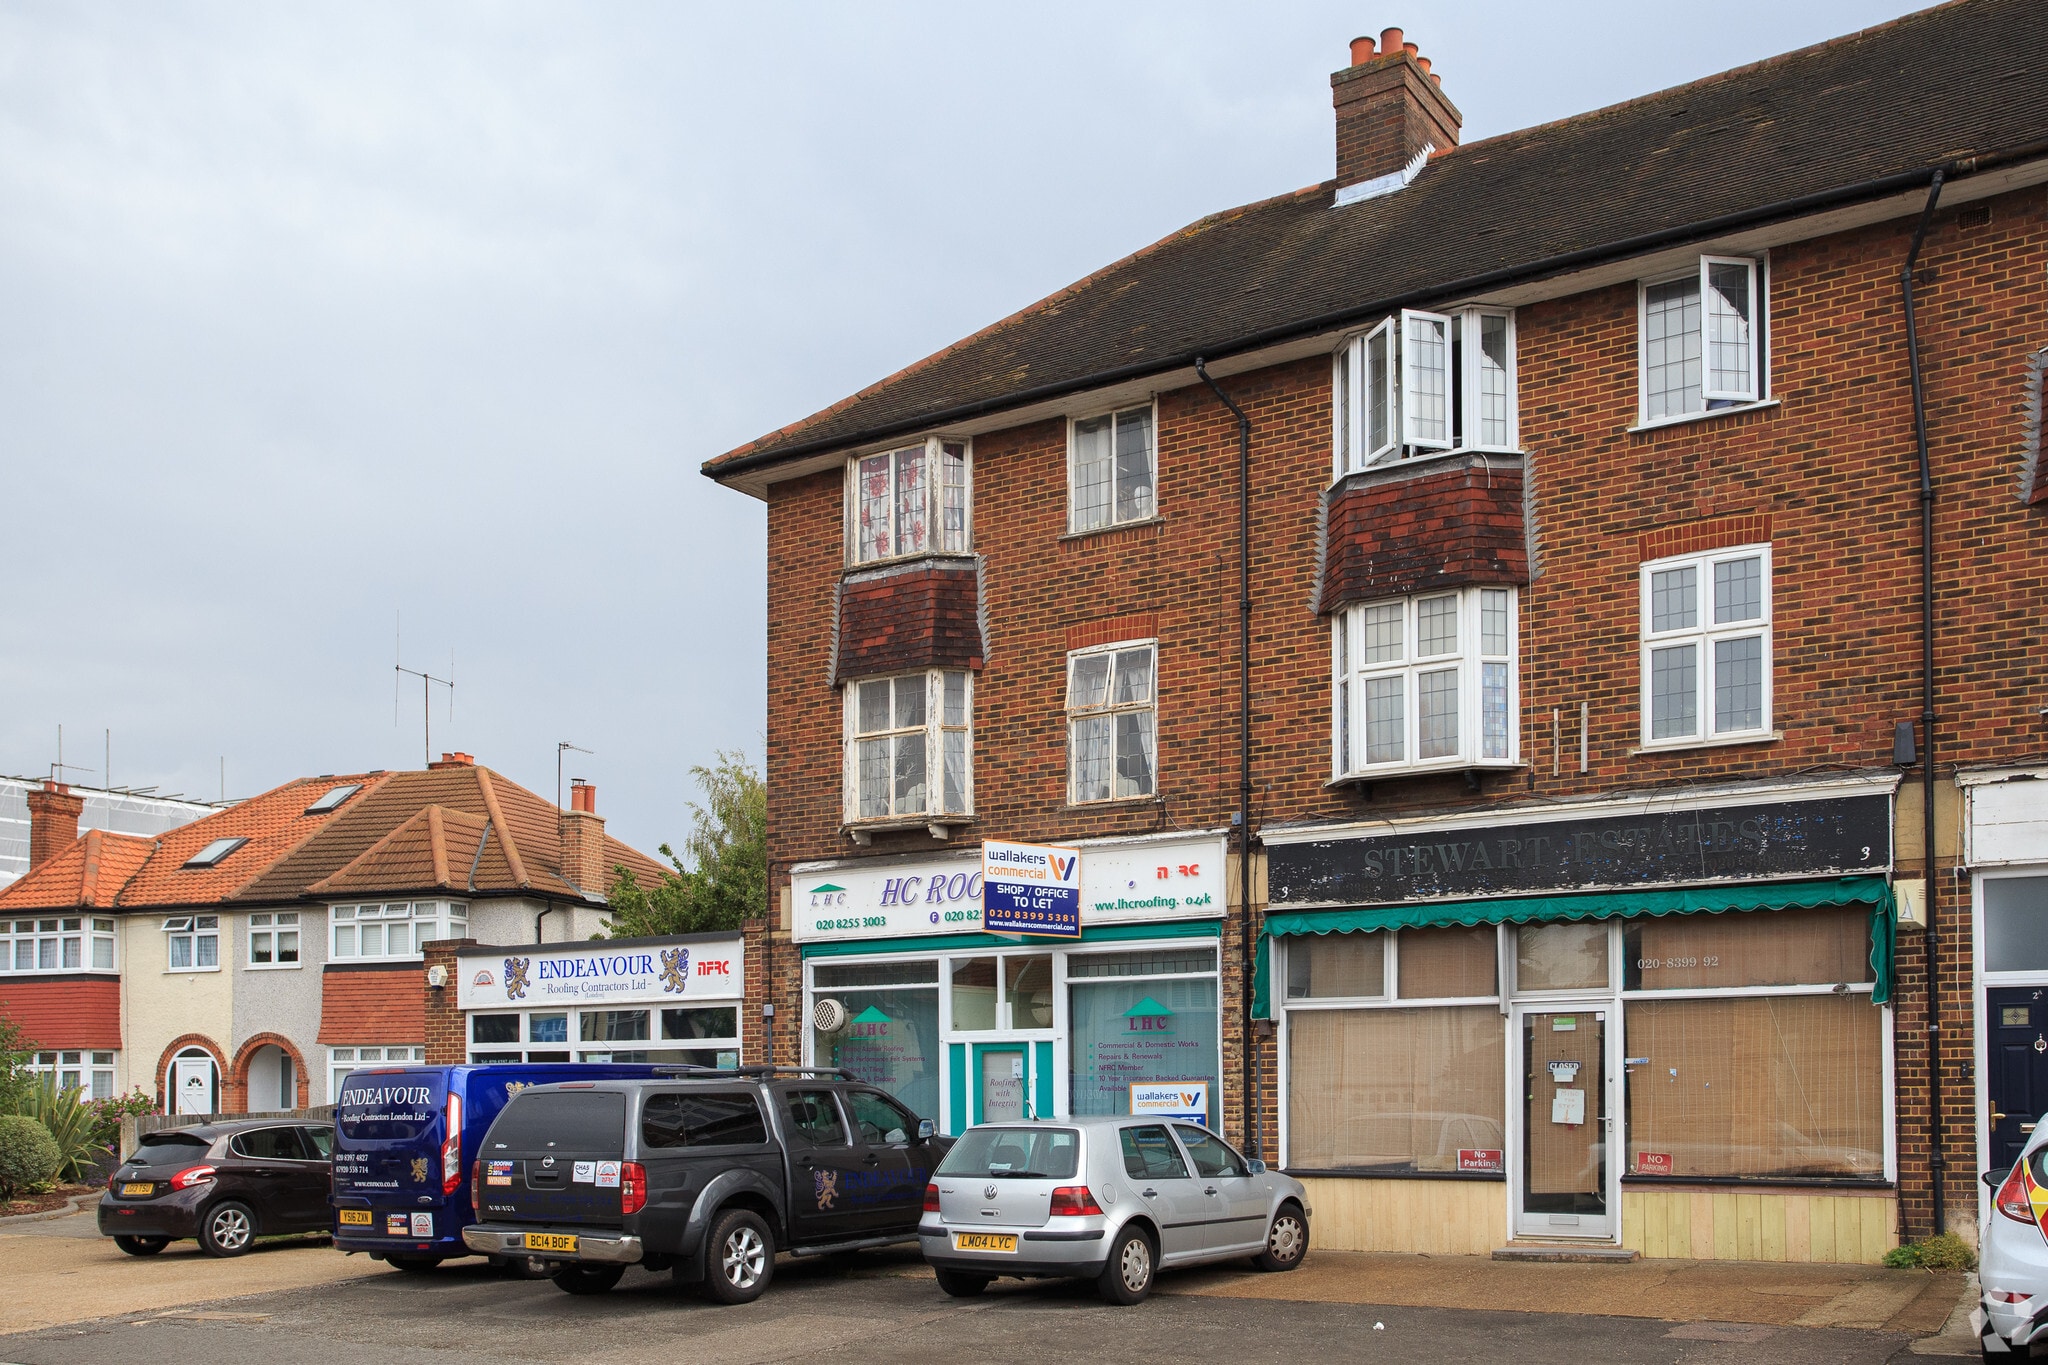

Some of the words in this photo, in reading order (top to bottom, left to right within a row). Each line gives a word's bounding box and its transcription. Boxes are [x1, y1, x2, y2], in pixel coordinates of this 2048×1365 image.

[1364, 837, 1551, 879] STEWART
[1570, 818, 1764, 863] ESTATES
[1860, 846, 1871, 861] 3
[988, 850, 1046, 865] wallakers
[988, 865, 1047, 880] commercial
[997, 884, 1025, 895] SHOP
[1034, 887, 1069, 899] OFFICE
[1282, 886, 1288, 898] 3
[1012, 896, 1029, 908] TO
[1032, 897, 1054, 910] LET
[944, 911, 964, 922] 020
[989, 908, 1011, 918] 020
[1014, 910, 1044, 920] 8399
[1047, 912, 1076, 922] 5381
[816, 919, 835, 930] 020
[836, 917, 860, 929] 8255
[862, 916, 887, 928] 3003
[988, 919, 1076, 931] www.wallakerscommercial.com
[538, 954, 655, 979] ENDEAVOUR
[1703, 956, 1719, 967] 92
[581, 981, 629, 993] Contractors
[1129, 1016, 1167, 1031] LHC
[856, 1023, 888, 1036] LHC
[883, 1045, 905, 1053] Roofing
[1145, 1040, 1176, 1048] Domestic
[1177, 1040, 1199, 1048] Works
[902, 1055, 926, 1063] Systems
[1098, 1053, 1122, 1061] Repairs
[1131, 1052, 1163, 1060] Renewals
[1549, 1062, 1579, 1070] CLOSED
[990, 1078, 1017, 1087] Roofing
[1181, 1073, 1215, 1081] Guarantee
[342, 1086, 431, 1107] ENDEAVOUR
[995, 1089, 1011, 1097] with
[1137, 1092, 1178, 1100] wallakers
[988, 1099, 1017, 1108] Integrity
[1137, 1100, 1179, 1108] commercial
[361, 1112, 389, 1121] Contractors
[390, 1112, 413, 1121] London
[1474, 1150, 1487, 1159] No
[1647, 1155, 1664, 1164] NO
[1464, 1159, 1497, 1169] Parking
[1641, 1163, 1668, 1171] PARKING
[359, 1166, 369, 1174] 714
[488, 1176, 511, 1185] WINNER
[845, 1168, 927, 1189] ENDEAVOUR
[530, 1235, 549, 1248] BC14
[961, 1235, 987, 1248] LM04
[990, 1237, 1012, 1249] LYC
